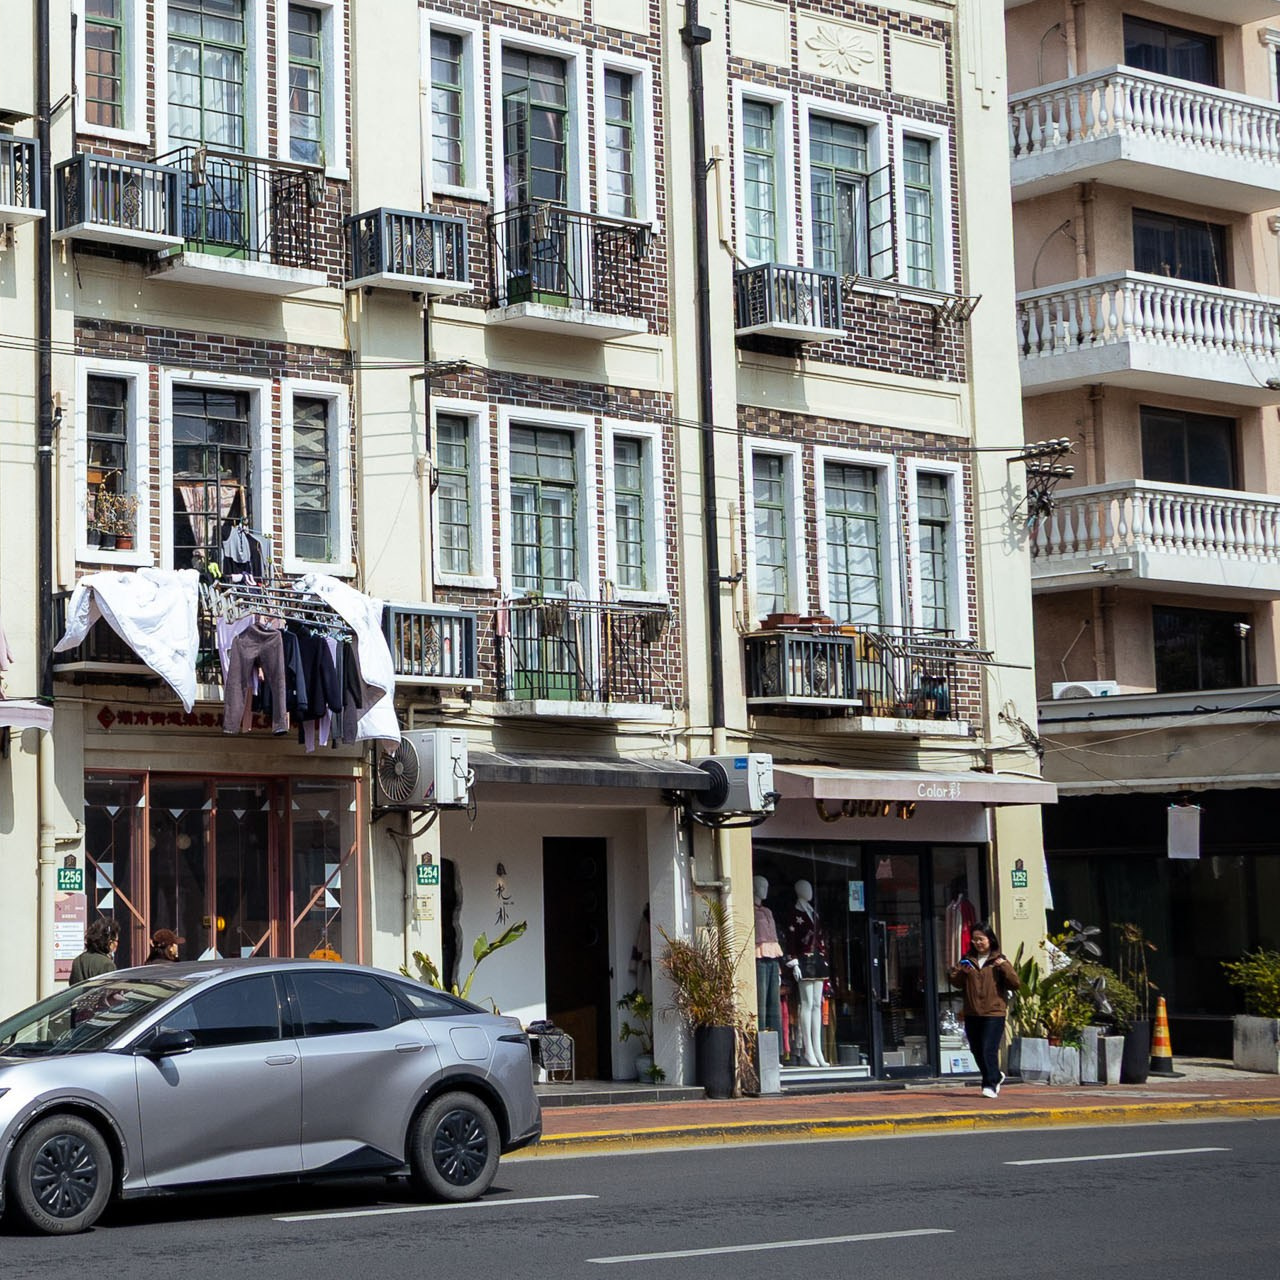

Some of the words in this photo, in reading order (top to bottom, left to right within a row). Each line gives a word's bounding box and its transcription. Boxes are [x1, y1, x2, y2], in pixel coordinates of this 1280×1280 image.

[917, 781, 961, 800] Color彩
[59, 870, 81, 883] 1256
[418, 867, 437, 878] 1254
[1012, 872, 1027, 882] 1252
